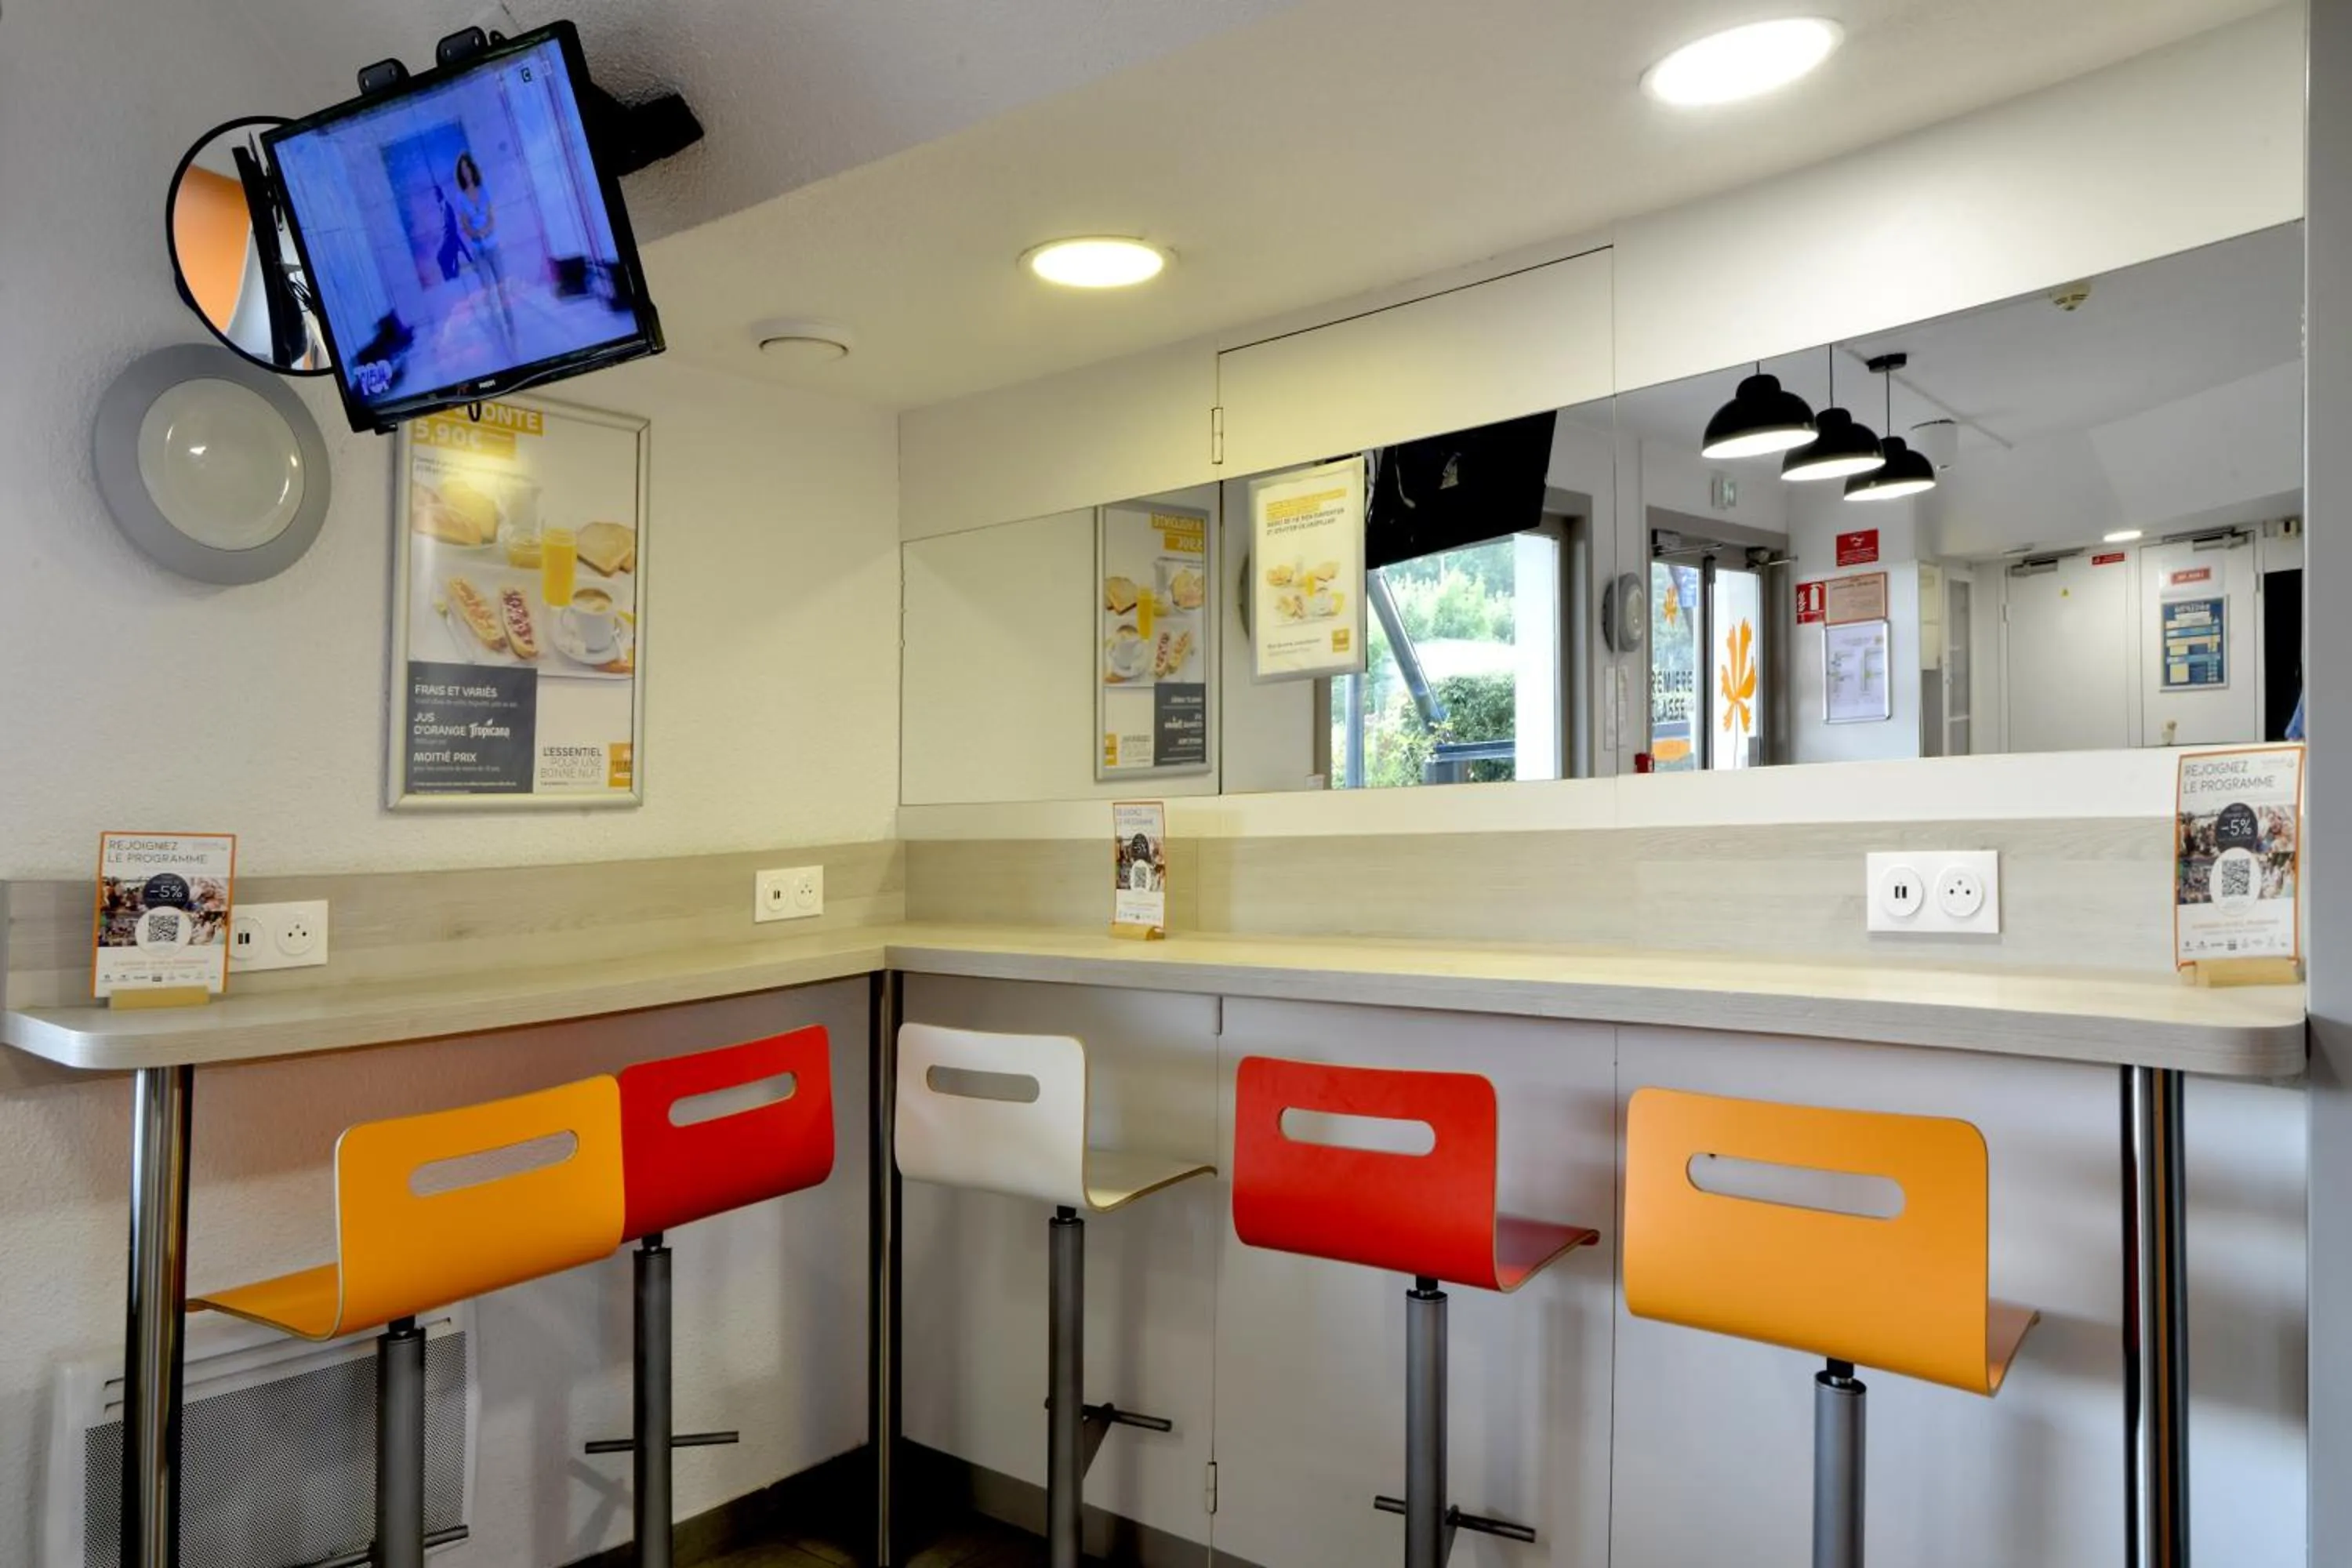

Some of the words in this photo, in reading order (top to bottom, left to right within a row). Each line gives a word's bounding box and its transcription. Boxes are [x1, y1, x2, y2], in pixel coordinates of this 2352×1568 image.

[1651, 670, 1693, 693] REMIERE
[414, 684, 445, 696] FRAIS
[448, 686, 459, 696] ET
[414, 713, 435, 723] JUS
[414, 725, 466, 737] D'ORANGE
[469, 720, 510, 740] Tropicana
[414, 750, 450, 763] MOITIÉ
[453, 752, 477, 763] PRIX
[543, 746, 602, 757] L'ESSENTIEL
[551, 757, 579, 768] POUR
[581, 757, 602, 768] UNE
[2183, 760, 2249, 777] REJOIGNEZ
[541, 768, 576, 779] BONNE
[579, 768, 604, 779] NUIT
[2183, 782, 2196, 794] LE
[2200, 774, 2276, 792] PROGRAMME
[2220, 817, 2252, 837] -5%
[108, 840, 180, 851] REJOIGNEZ
[107, 854, 122, 864] LE
[126, 853, 209, 865] PROGRAMME
[150, 885, 183, 898] -5%
